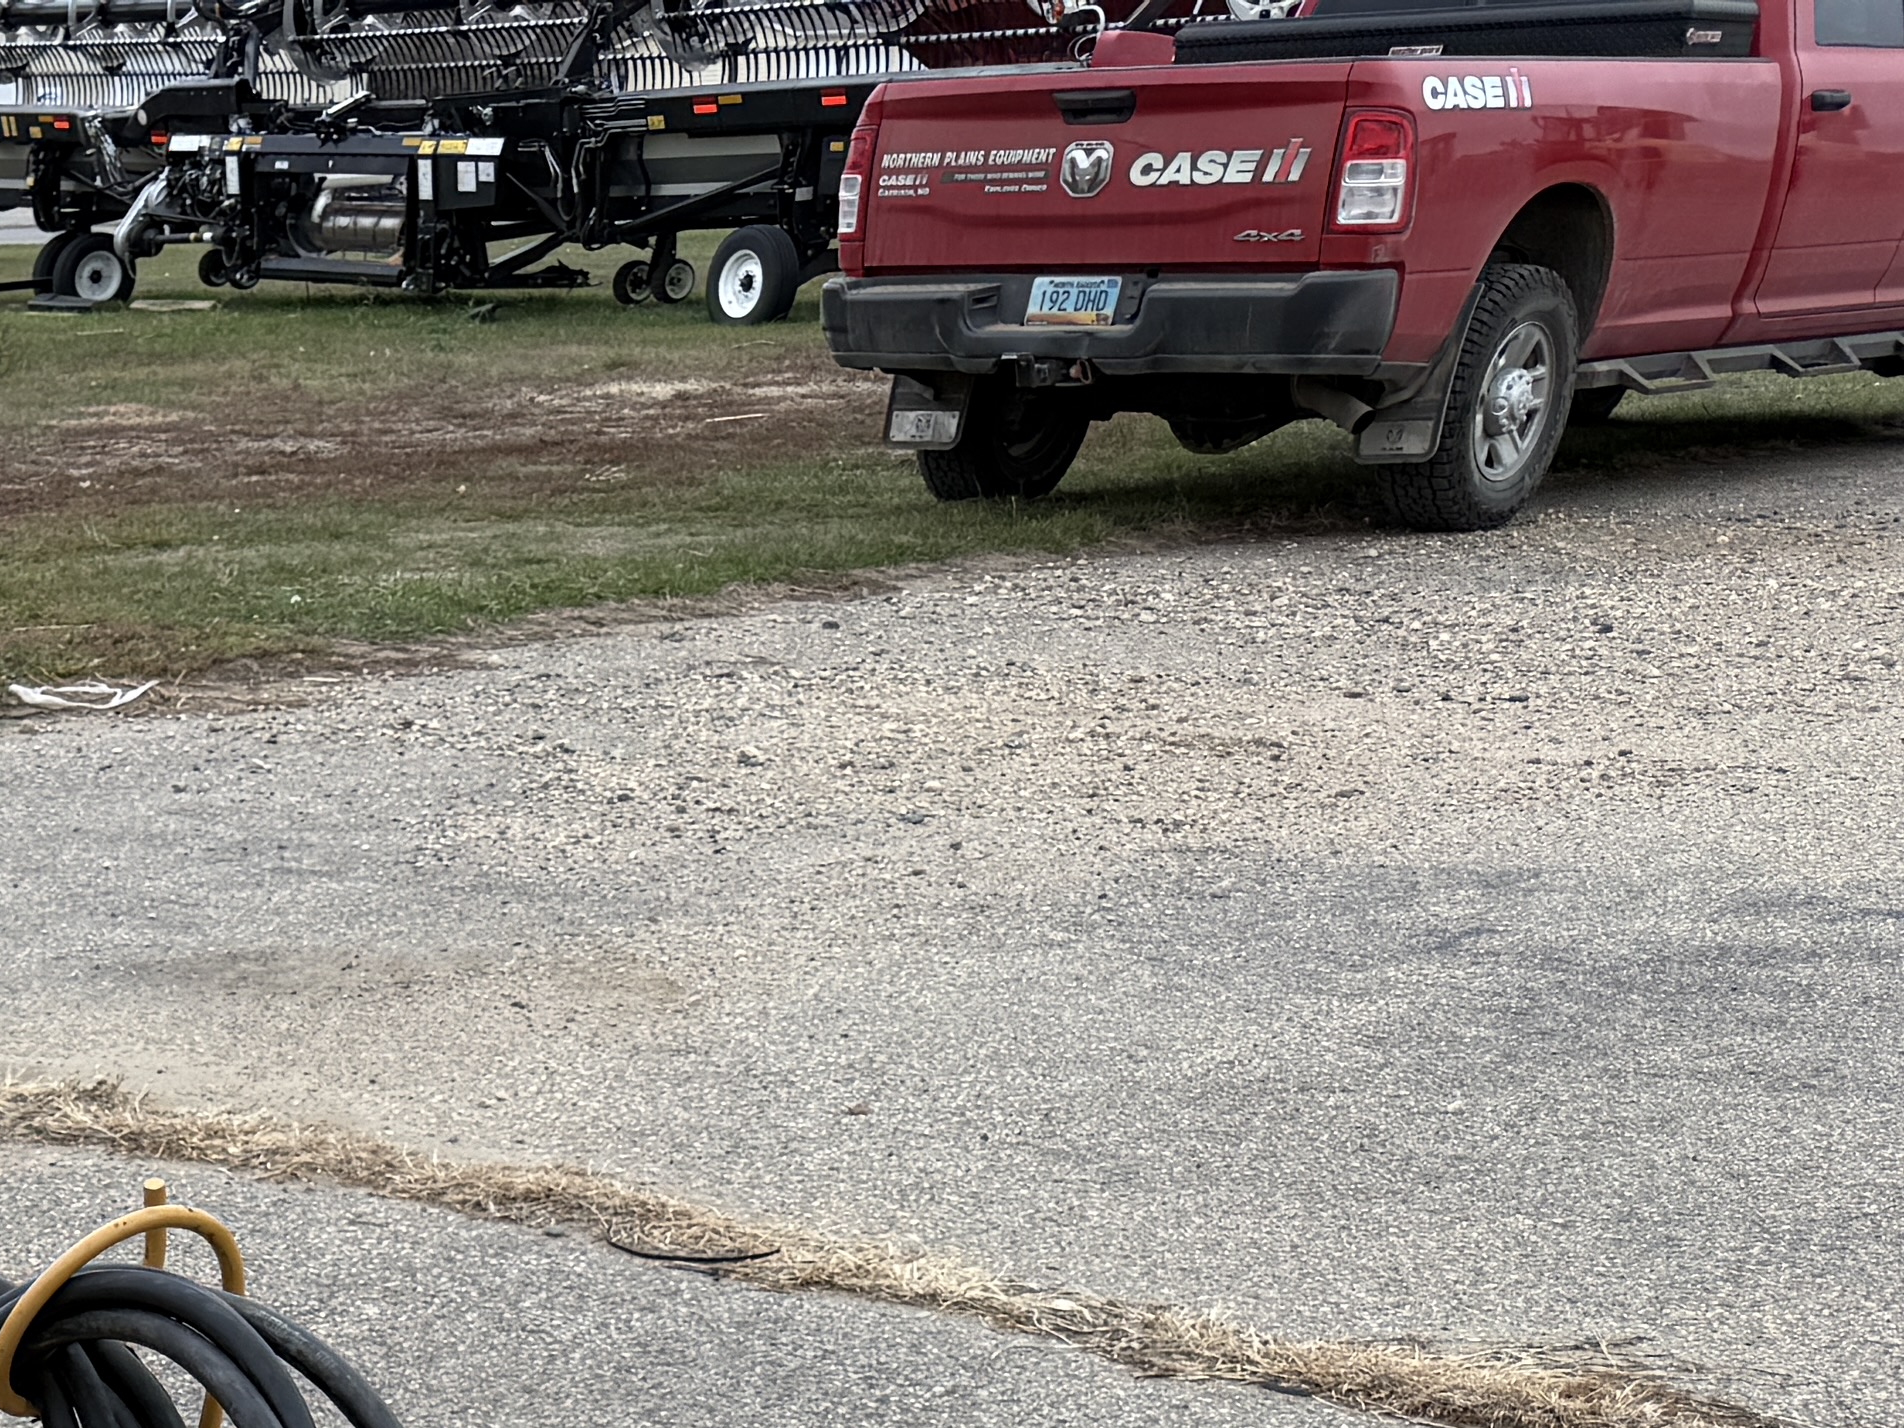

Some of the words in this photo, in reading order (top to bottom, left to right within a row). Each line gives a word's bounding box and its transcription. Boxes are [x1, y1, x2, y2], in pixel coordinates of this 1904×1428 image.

[1422, 75, 1505, 110] CASE
[881, 152, 941, 168] NORTHERN
[943, 150, 984, 167] PLAINS
[988, 148, 1056, 165] EQUIPMENT
[1129, 149, 1264, 187] CASE
[879, 174, 916, 186] CASE
[1233, 229, 1305, 242] 4x4
[1039, 289, 1071, 312] 192
[1073, 289, 1109, 312] DHD
